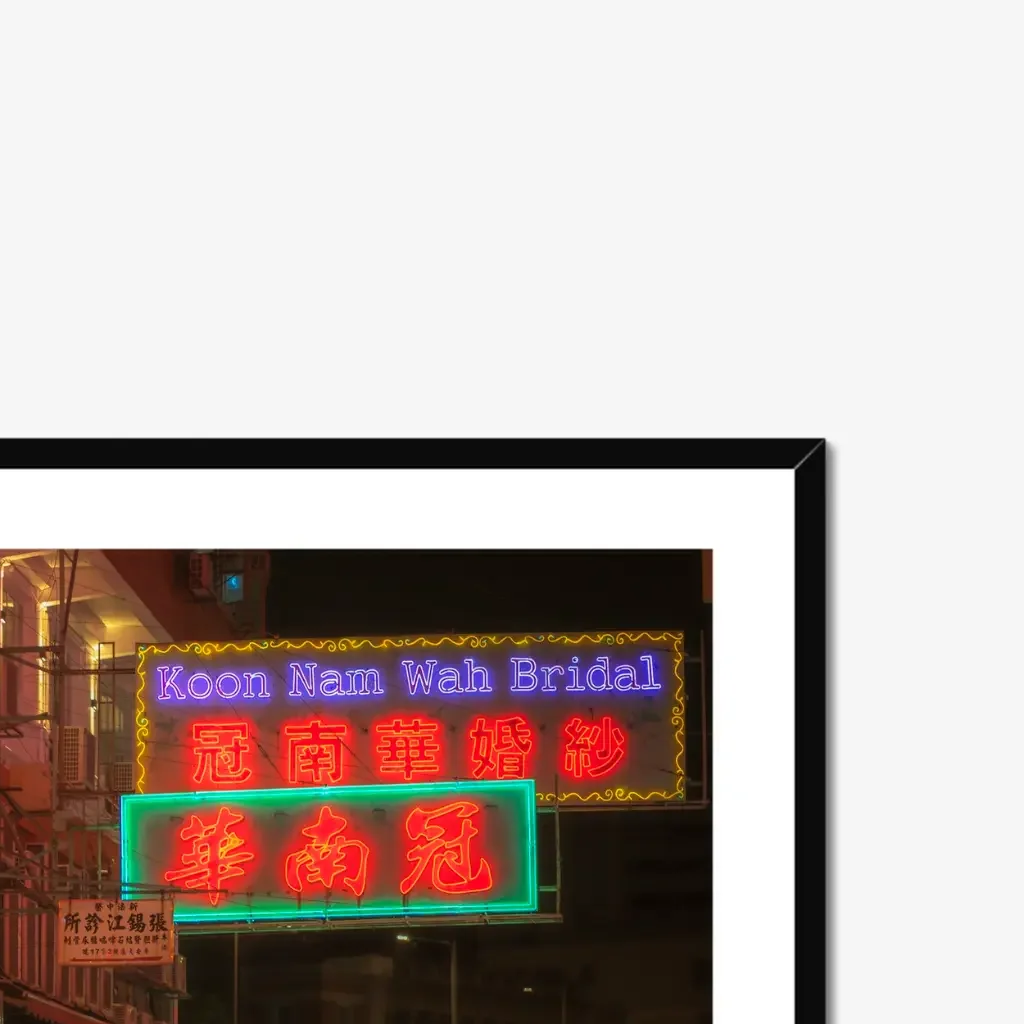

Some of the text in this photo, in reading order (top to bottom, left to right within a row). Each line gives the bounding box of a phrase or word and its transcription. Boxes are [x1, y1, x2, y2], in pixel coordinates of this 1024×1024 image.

[156, 654, 662, 702] Koon Nam Wah Bridal
[192, 716, 626, 785] 冠南華婚紗
